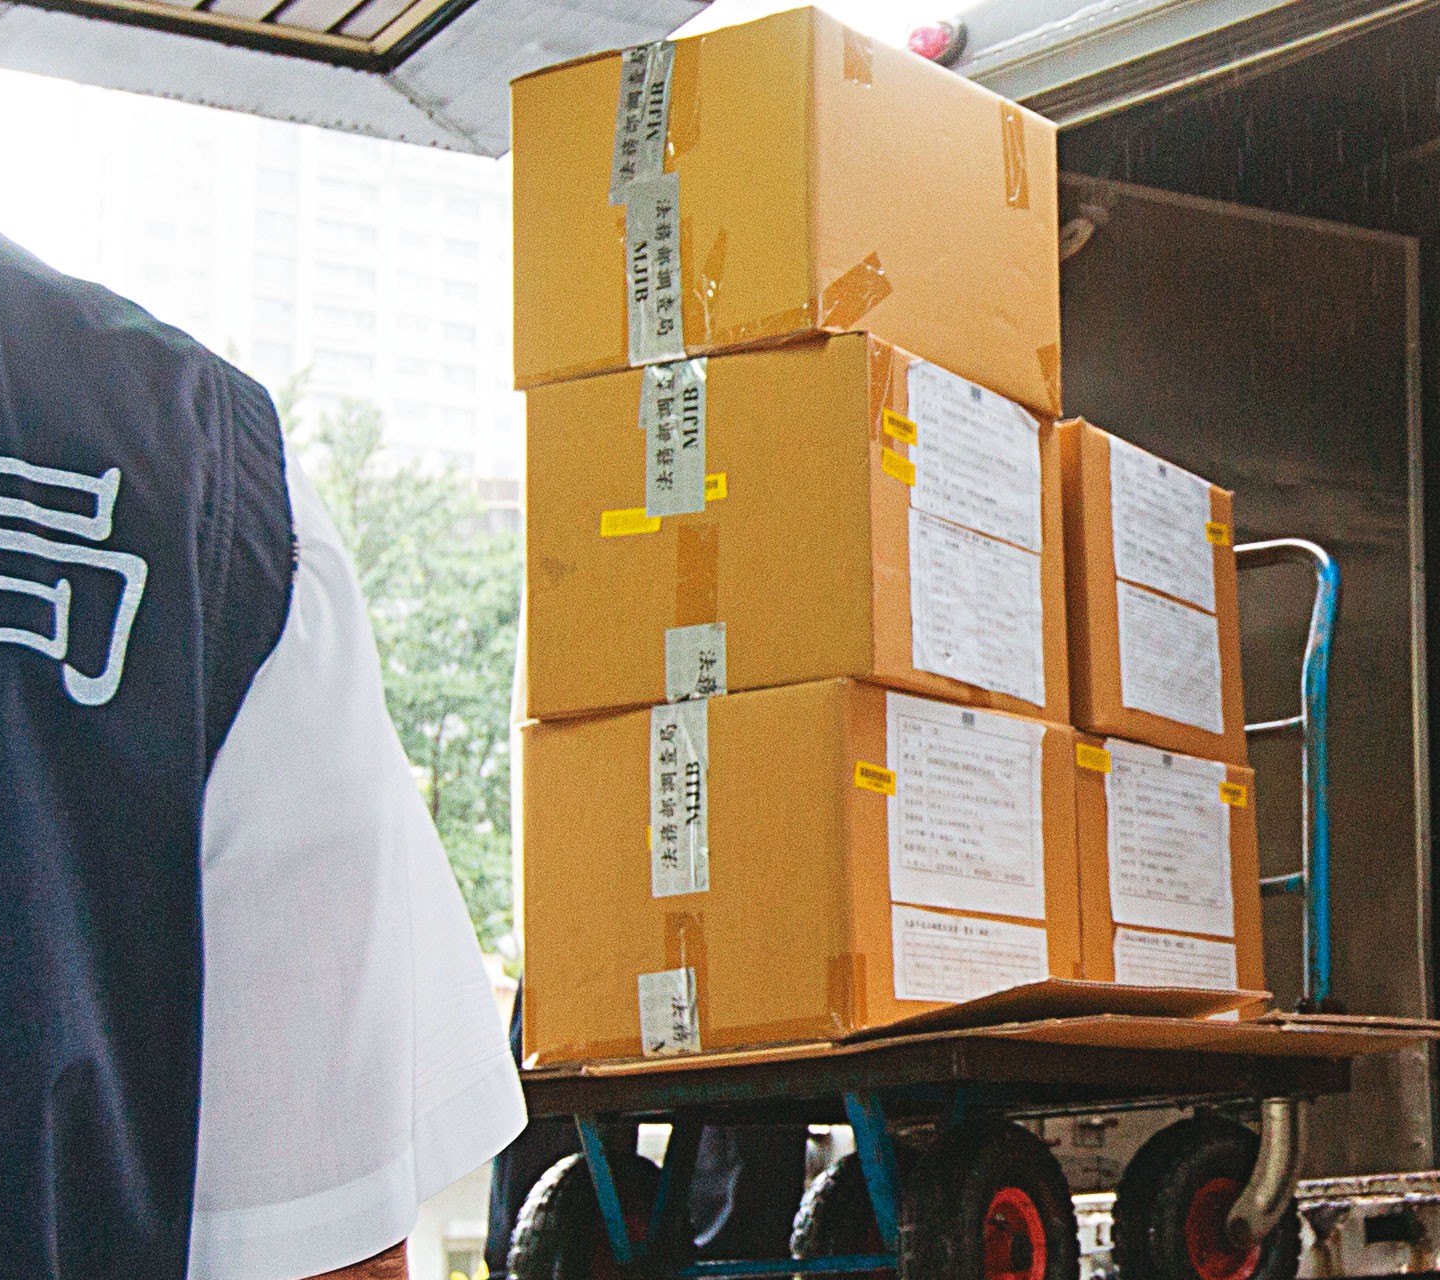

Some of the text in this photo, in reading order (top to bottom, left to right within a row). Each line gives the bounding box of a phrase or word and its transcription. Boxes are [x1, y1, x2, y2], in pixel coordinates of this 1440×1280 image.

[645, 81, 665, 141] MJIB
[633, 239, 649, 303] MJIB
[683, 386, 699, 450] MJIB
[659, 722, 678, 869] 法務部調查局
[686, 761, 701, 826] MJIB
